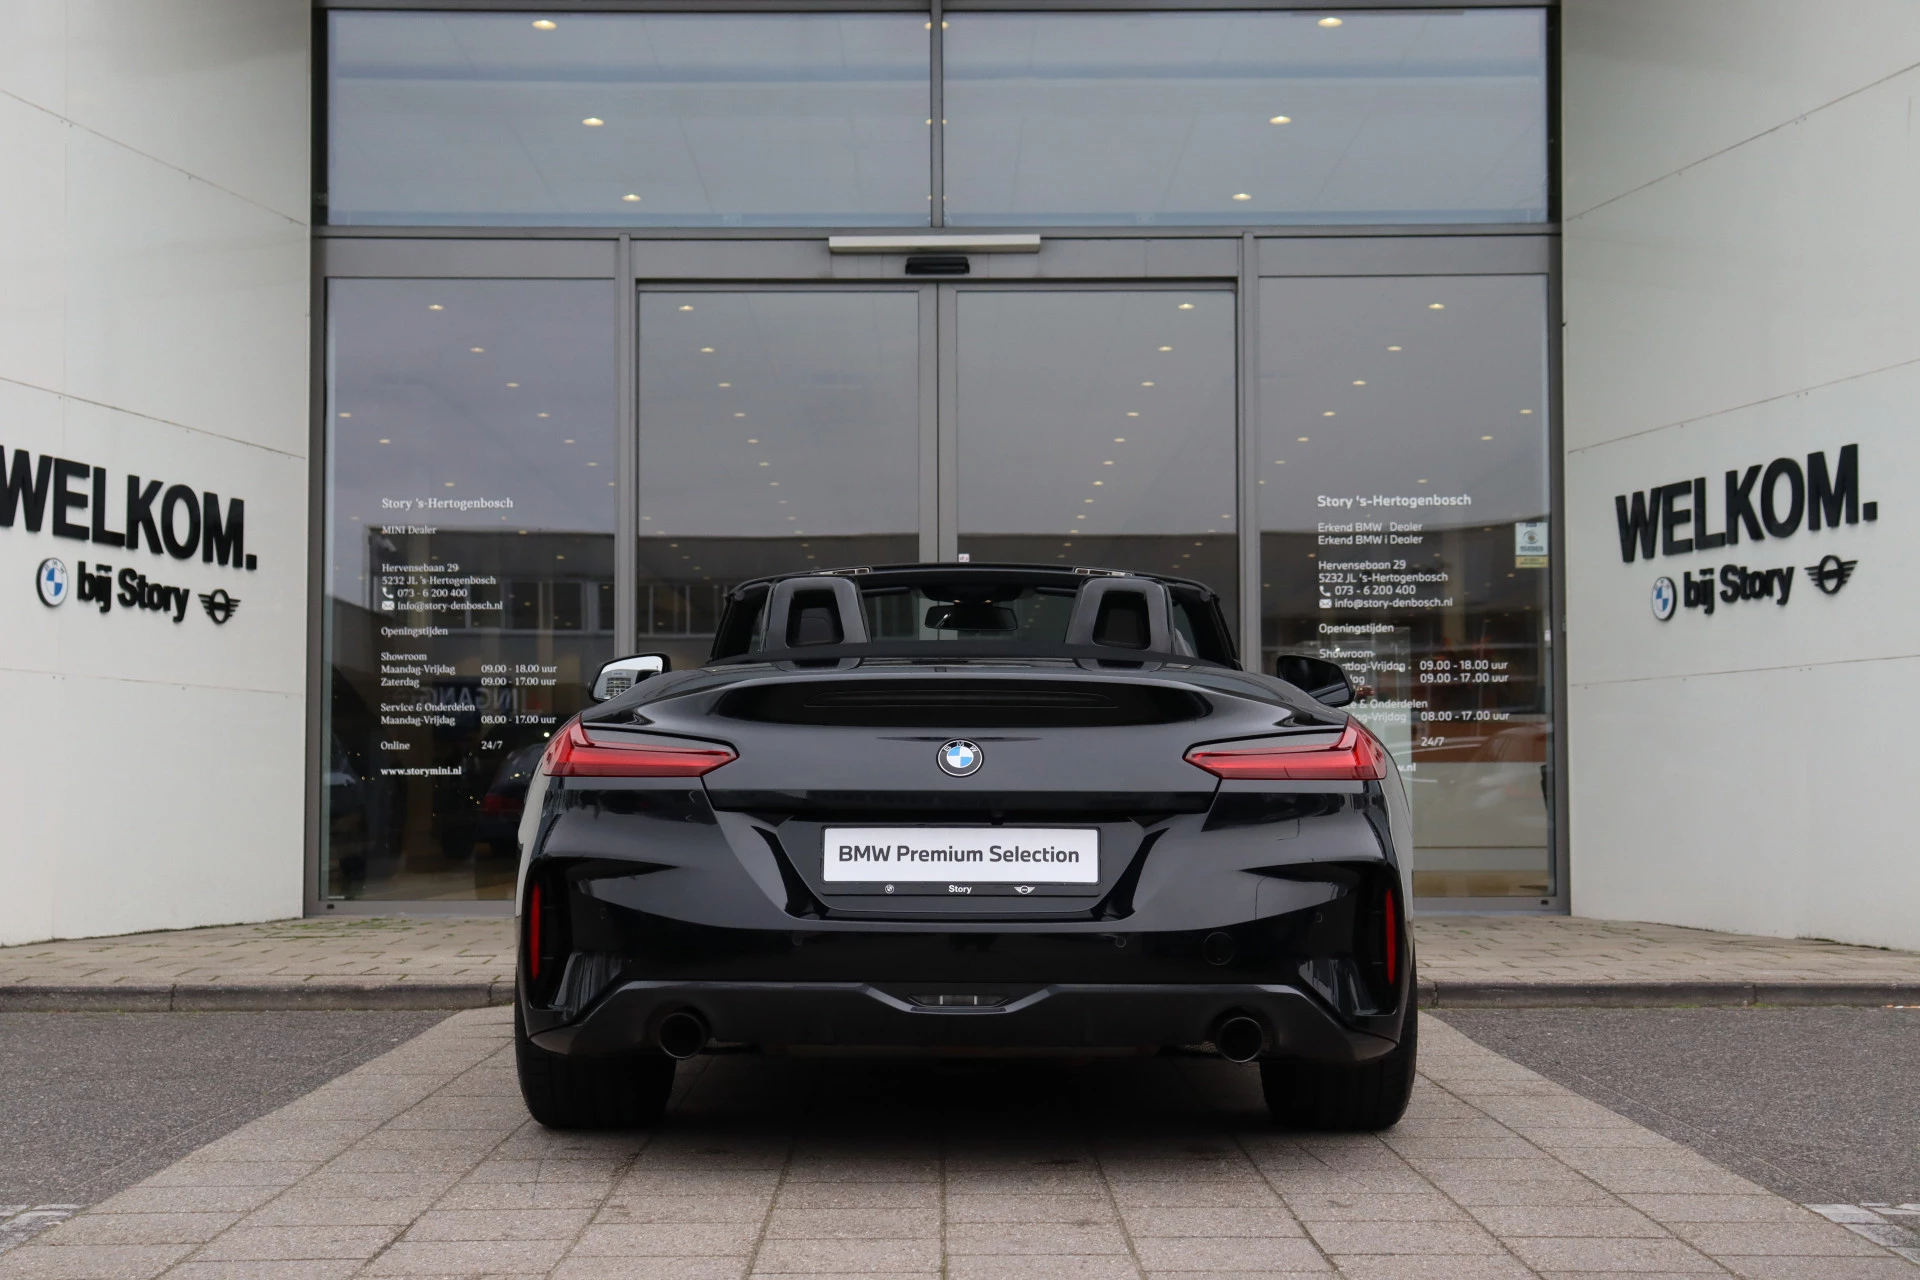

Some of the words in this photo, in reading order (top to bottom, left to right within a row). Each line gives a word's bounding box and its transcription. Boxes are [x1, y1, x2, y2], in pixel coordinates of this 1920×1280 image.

[382, 498, 412, 511] Story
[416, 497, 513, 511] 's-Hertogenbosch
[1317, 495, 1353, 509] Story
[1356, 494, 1471, 508] 's-Hertogenbosch
[1615, 443, 1878, 563] WELKOM.
[0, 444, 257, 571] WELKOM.
[381, 526, 405, 534] MINI
[408, 525, 436, 534] Dealer
[1318, 523, 1352, 532] Erkend
[1355, 522, 1382, 532] BMW
[1390, 522, 1422, 531] Dealer
[1318, 535, 1353, 545] Erkend
[1356, 535, 1382, 544] BMW
[1390, 535, 1423, 544] Dealer
[382, 563, 445, 572] Hervensebaan
[447, 563, 459, 572] 29
[1319, 560, 1391, 570] Hervensebaan
[1393, 560, 1406, 569] 29
[382, 576, 404, 585] 5232
[407, 576, 418, 585] JL
[420, 576, 496, 587] 's-Hertogenbosch
[1319, 573, 1343, 583] 5232
[1345, 573, 1357, 583] JL
[1359, 572, 1448, 586] 's-Hertogenbosch
[77, 561, 112, 614] bij
[117, 568, 190, 624] Story
[397, 589, 414, 597] 073
[423, 589, 429, 597] 6
[431, 589, 448, 597] 200
[450, 589, 468, 597] 400
[1335, 585, 1353, 595] 073
[1363, 586, 1370, 595] 6
[1372, 585, 1393, 595] 200
[1395, 585, 1416, 594] 400
[1683, 567, 1715, 615] bij
[1719, 564, 1795, 606] Story
[398, 600, 503, 613] info@story-denbosch.nl
[1335, 598, 1452, 609] info@story-denbosch.nl
[381, 626, 448, 638] Openingstijden
[1319, 623, 1394, 635] Openingstijden
[381, 652, 427, 661] Showroom
[381, 664, 456, 676] Maandag-Vrijdag
[481, 665, 507, 673] 09.00
[516, 664, 539, 673] 18.00
[1420, 660, 1450, 670] 09.00
[1460, 660, 1489, 670] 18.00
[381, 677, 420, 688] Zaterdag
[481, 677, 507, 686] 09.00
[516, 677, 539, 686] 17.00
[1420, 673, 1451, 683] 09.00
[381, 703, 414, 711] Service
[416, 703, 422, 711] &
[424, 702, 475, 711] Onderdelen
[1360, 699, 1367, 708] &
[1370, 699, 1428, 708] Onderdelen
[381, 715, 456, 726] Maandag-Vrijdag
[481, 715, 506, 724] 08.00
[515, 715, 539, 724] 17.00
[1421, 711, 1453, 721] 08.00
[381, 741, 410, 750] Online
[481, 741, 503, 749] 24/7
[1421, 737, 1445, 748] 24/7
[381, 766, 461, 777] www.storymini.nl
[839, 845, 891, 862] BMW
[896, 845, 983, 862] Premium
[989, 845, 1079, 863] Selection
[948, 884, 973, 894] Story
